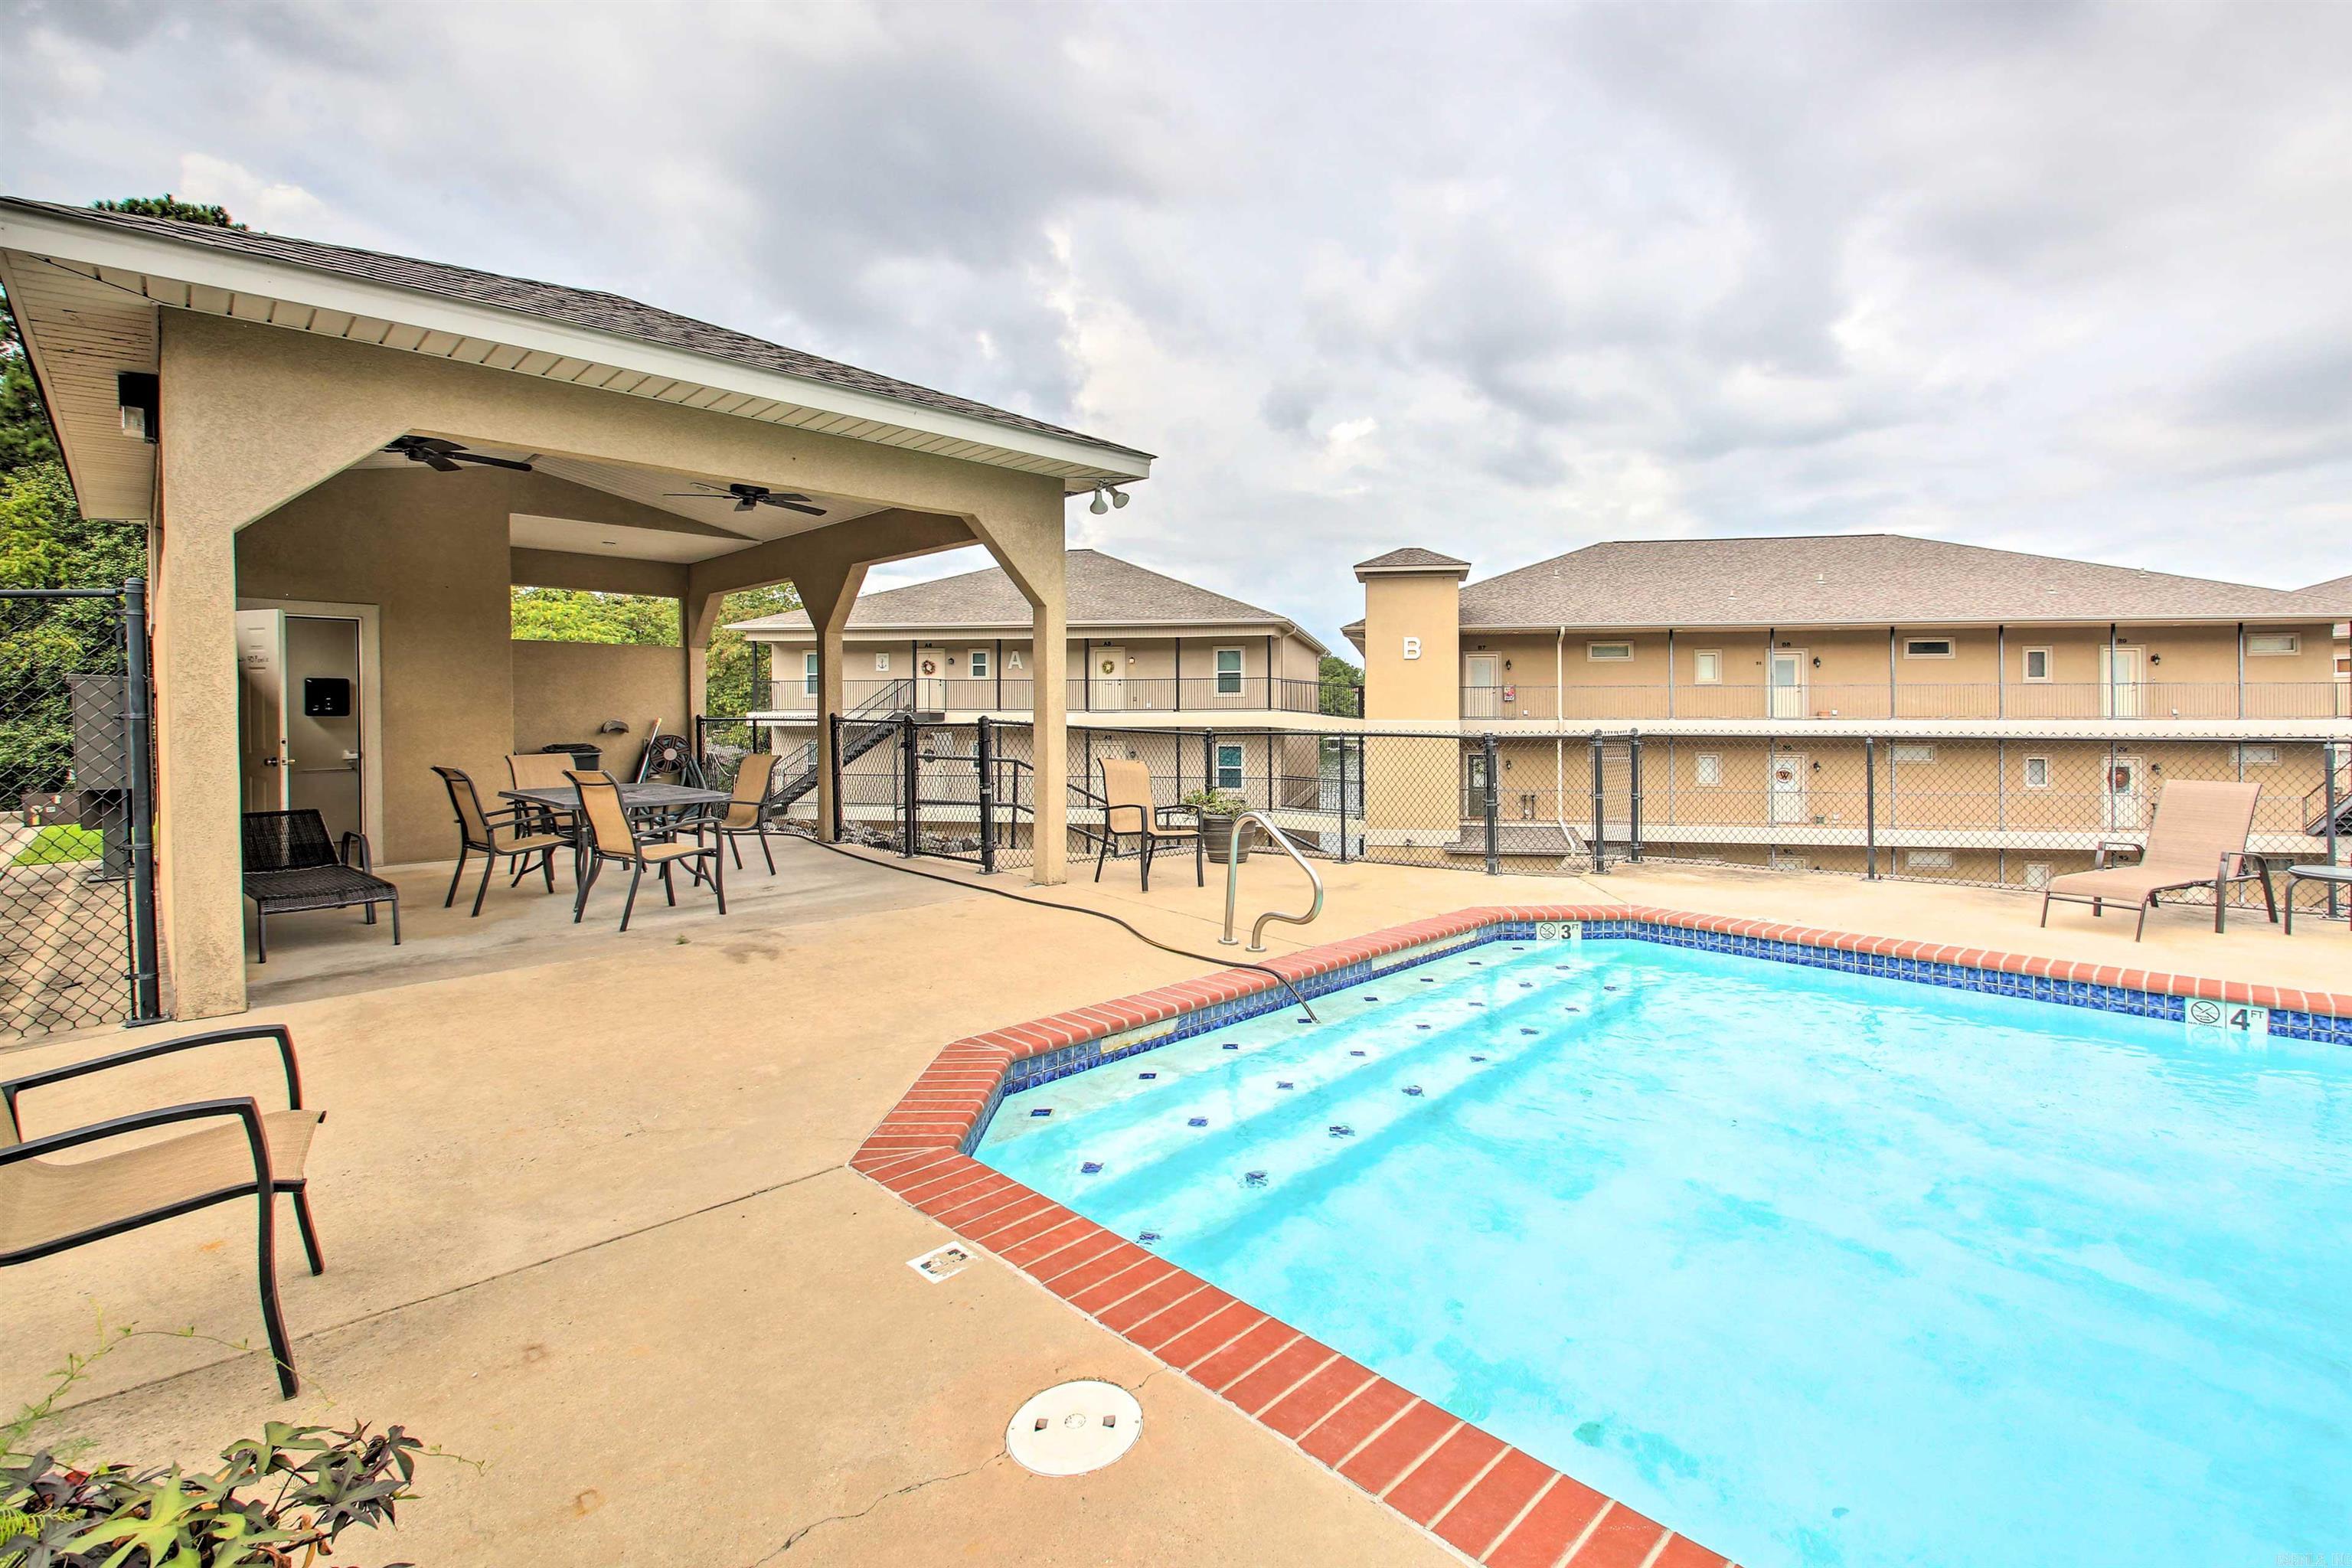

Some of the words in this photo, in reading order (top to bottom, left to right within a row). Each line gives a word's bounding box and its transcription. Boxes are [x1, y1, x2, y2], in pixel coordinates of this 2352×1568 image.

[1403, 637, 1421, 660] B
[1008, 650, 1023, 669] A
[1779, 771, 1791, 779] W
[1561, 924, 1572, 939] 3
[2230, 1008, 2250, 1031] 4
[2251, 1010, 2264, 1019] FT
